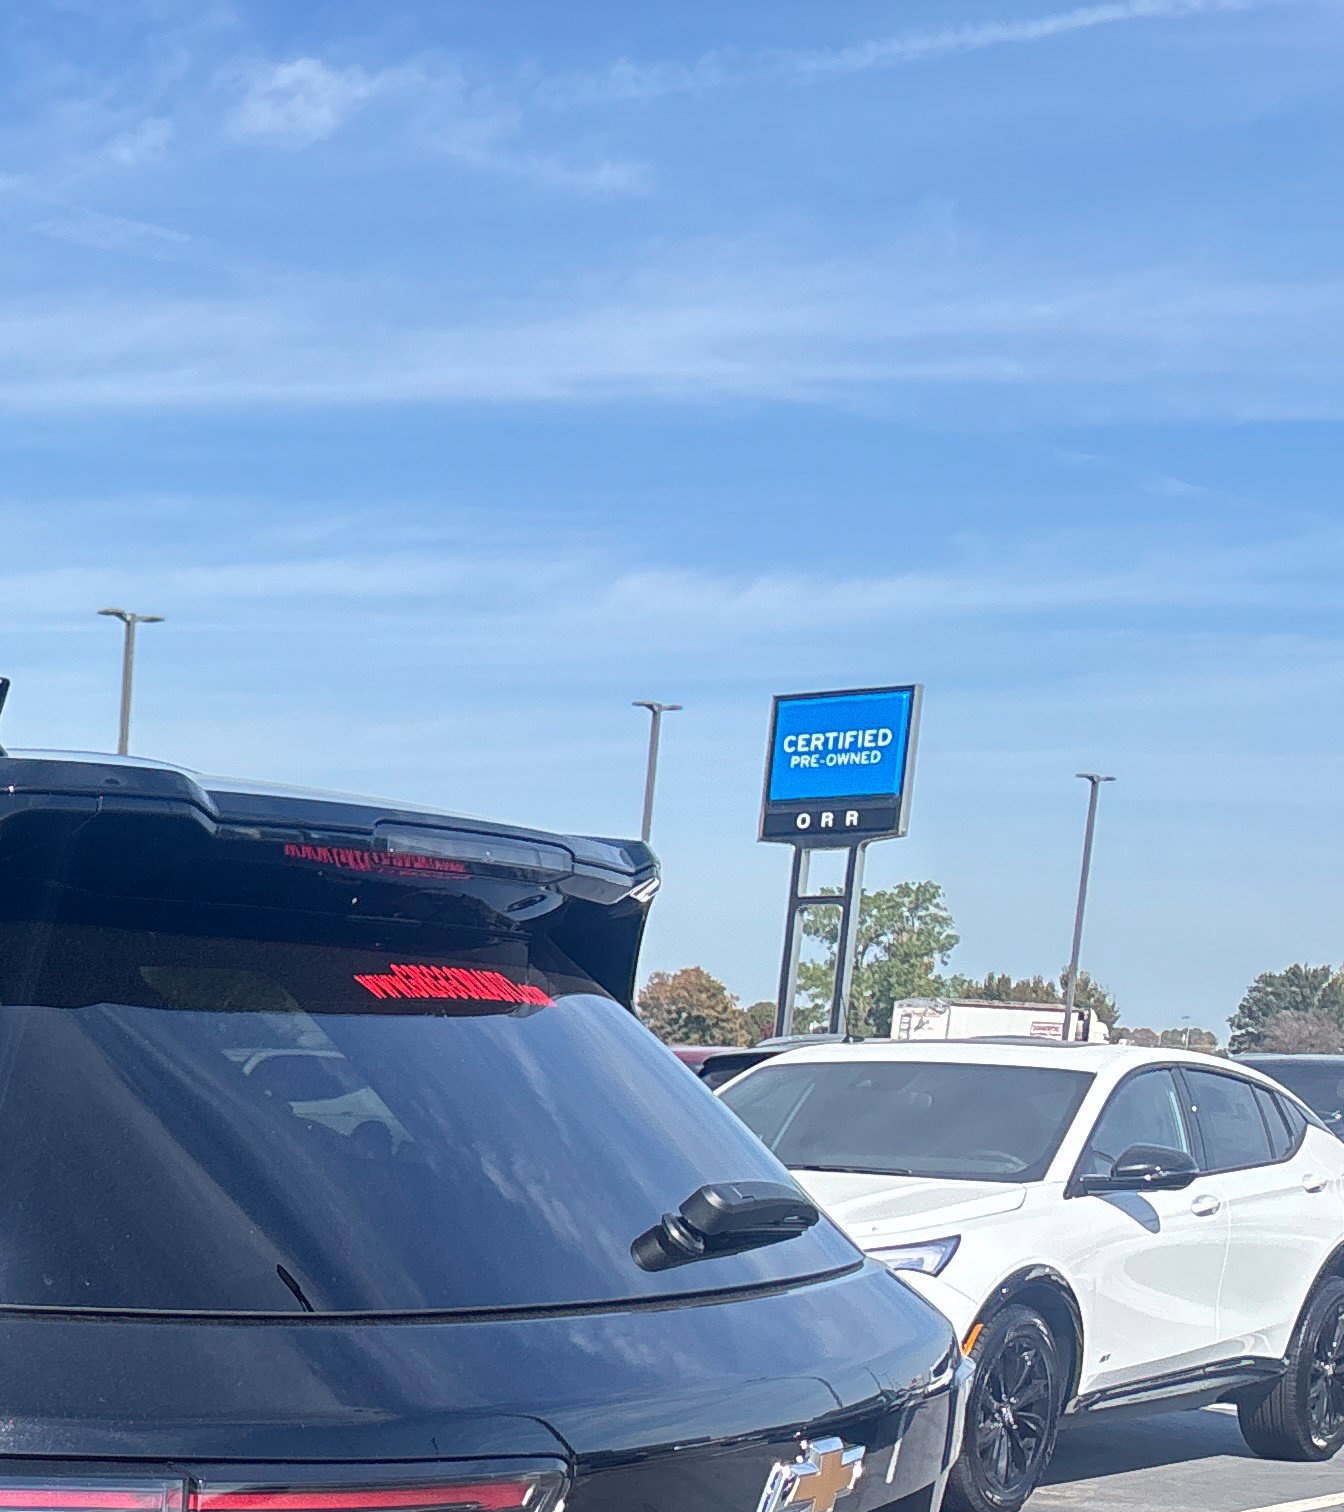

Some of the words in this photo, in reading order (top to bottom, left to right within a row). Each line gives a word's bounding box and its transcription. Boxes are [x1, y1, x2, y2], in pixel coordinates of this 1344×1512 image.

[783, 728, 893, 753] CERTIFIED
[790, 750, 882, 769] PRE-OWNED
[796, 810, 859, 829] ORR
